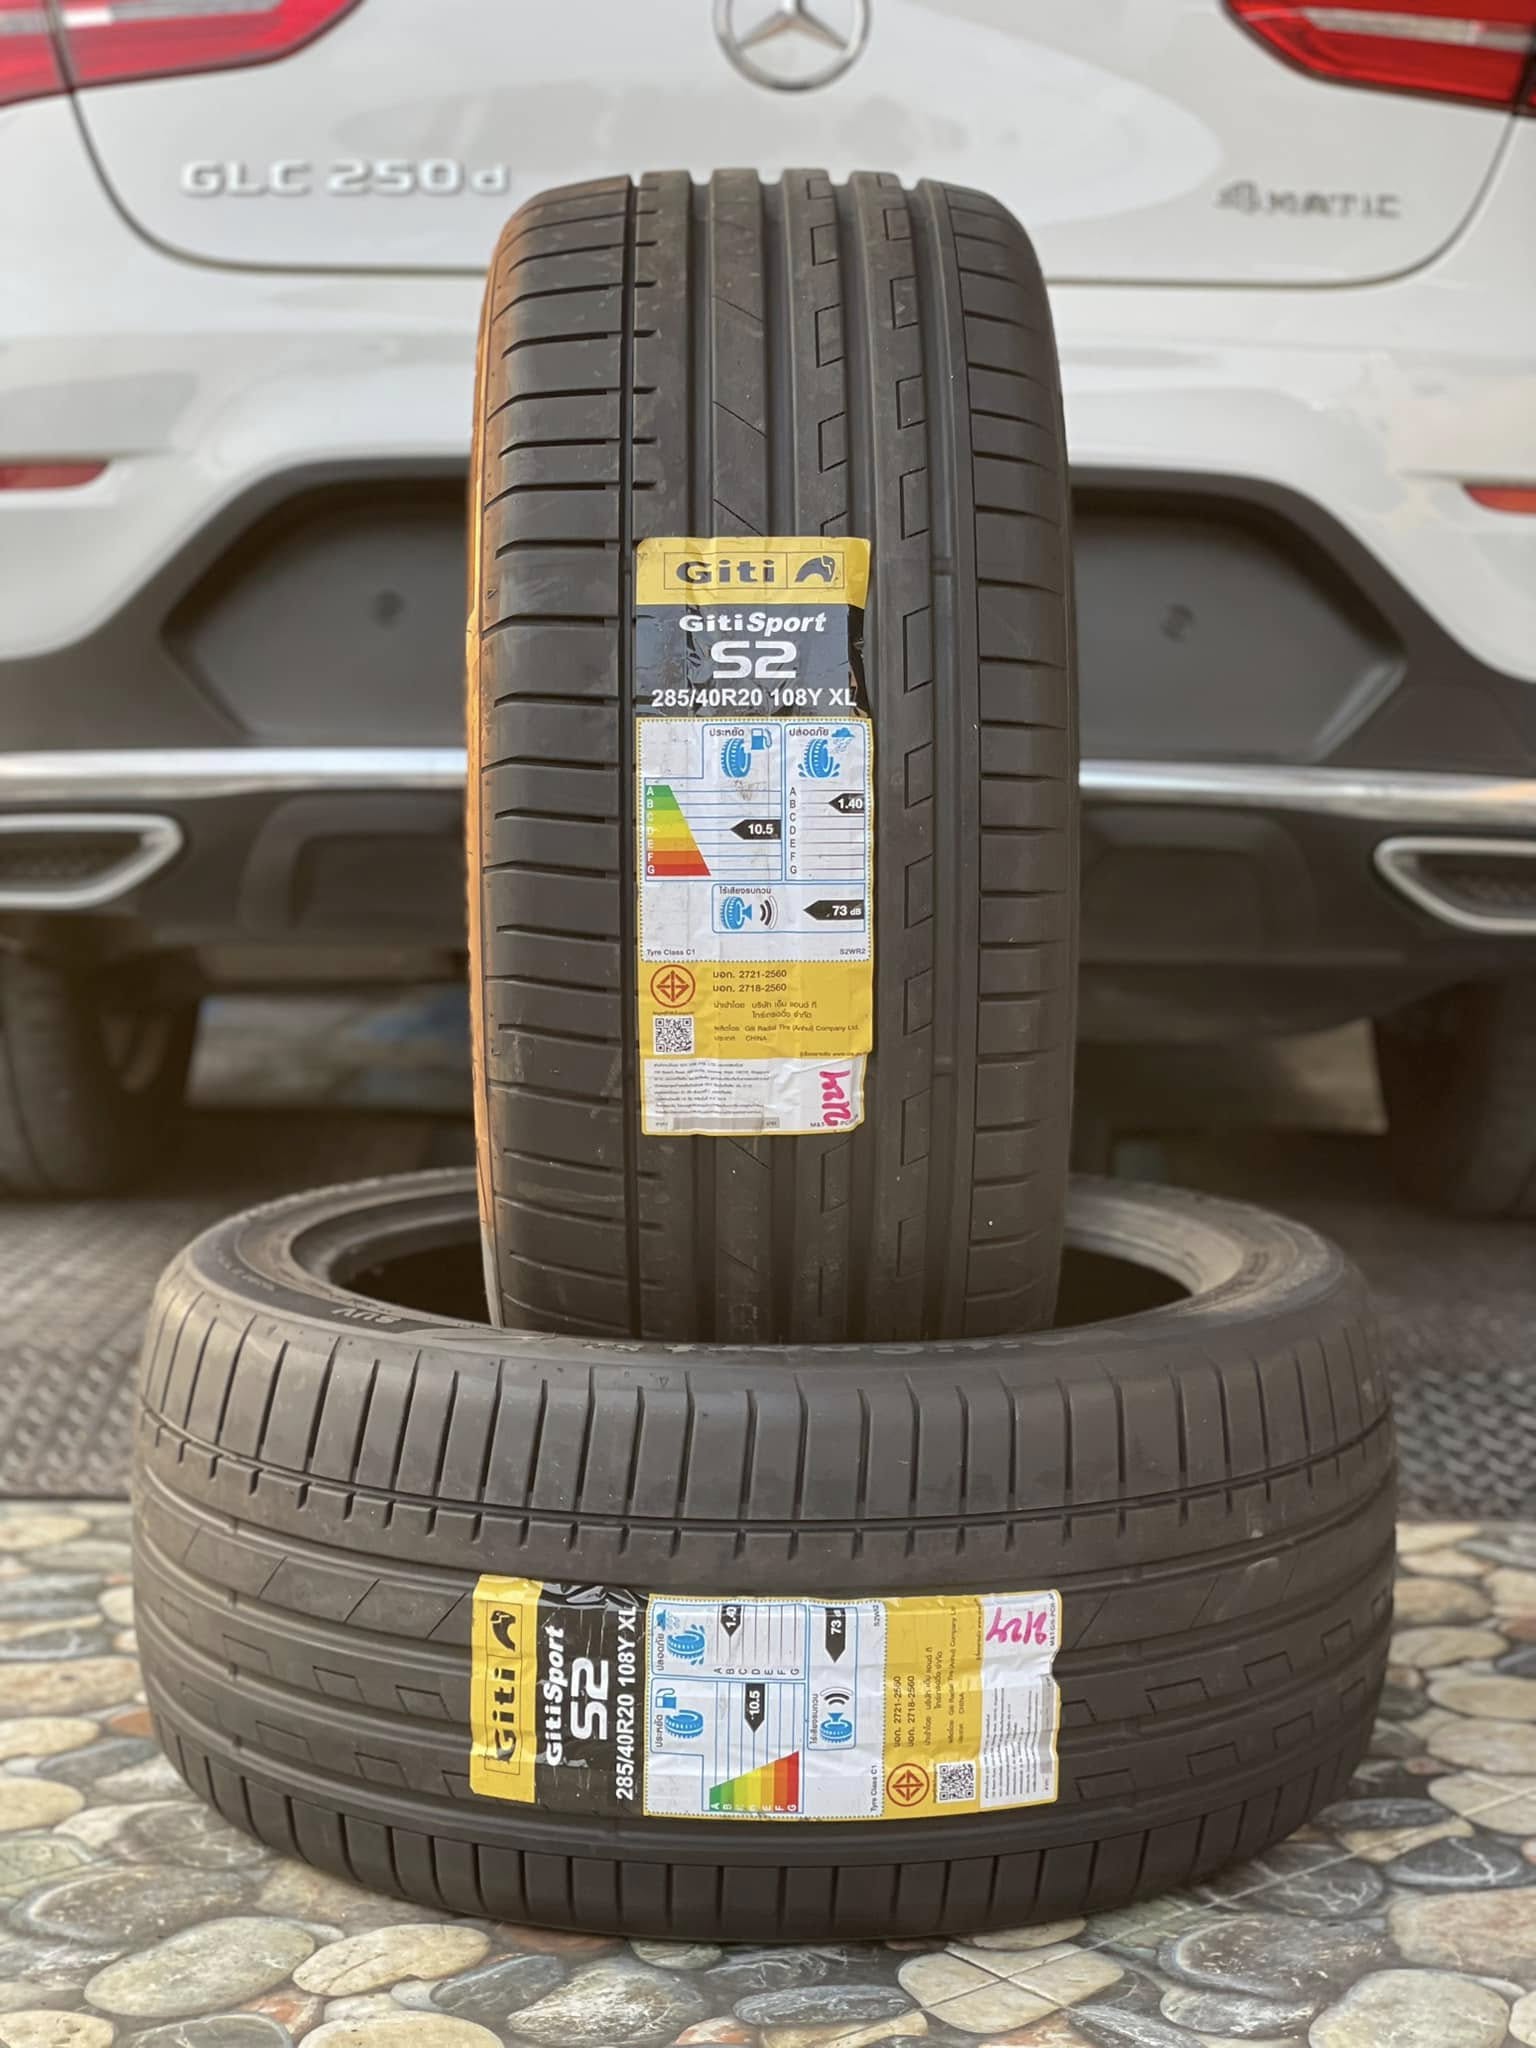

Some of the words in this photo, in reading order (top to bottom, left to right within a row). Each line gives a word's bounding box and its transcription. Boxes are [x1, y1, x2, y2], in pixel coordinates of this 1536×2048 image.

[181, 159, 311, 198] GLC
[1217, 181, 1401, 219] 4MATIC
[676, 559, 775, 584] Giti
[679, 611, 827, 637] GitiSport
[710, 640, 797, 679] S2
[651, 688, 762, 707] 285/40R20
[770, 688, 823, 706] 108Y
[828, 688, 857, 707] XL
[709, 727, 745, 737] ประหยัด
[789, 727, 829, 737] ปลอดภัย
[647, 787, 654, 796] A
[790, 787, 796, 796] A
[647, 800, 654, 808] B
[790, 800, 796, 809] B
[838, 799, 863, 809] 1.40
[790, 813, 796, 822] C
[748, 824, 774, 835] 10.5
[790, 826, 796, 835] D
[790, 839, 796, 848] E
[648, 853, 654, 862] F
[791, 852, 796, 861] F
[647, 865, 655, 874] G
[790, 865, 797, 874] G
[832, 906, 848, 916] 73
[646, 949, 661, 957] Tyre
[713, 970, 735, 979] มอก.
[738, 969, 787, 978] 2721-2560
[713, 984, 735, 993] มอก.
[738, 983, 787, 992] 2718-2560
[815, 1025, 845, 1033] Company
[617, 1605, 636, 1632] XL
[831, 1620, 841, 1635] 73
[617, 1636, 636, 1687] 108Y
[543, 1625, 568, 1766] GitiSport
[570, 1657, 608, 1741] S2
[907, 1675, 915, 1723] 2718-2560
[749, 1690, 760, 1717] 10.5
[494, 1668, 517, 1763] Giti
[615, 1694, 635, 1801] 285/40R20
[871, 1765, 877, 1775] C1
